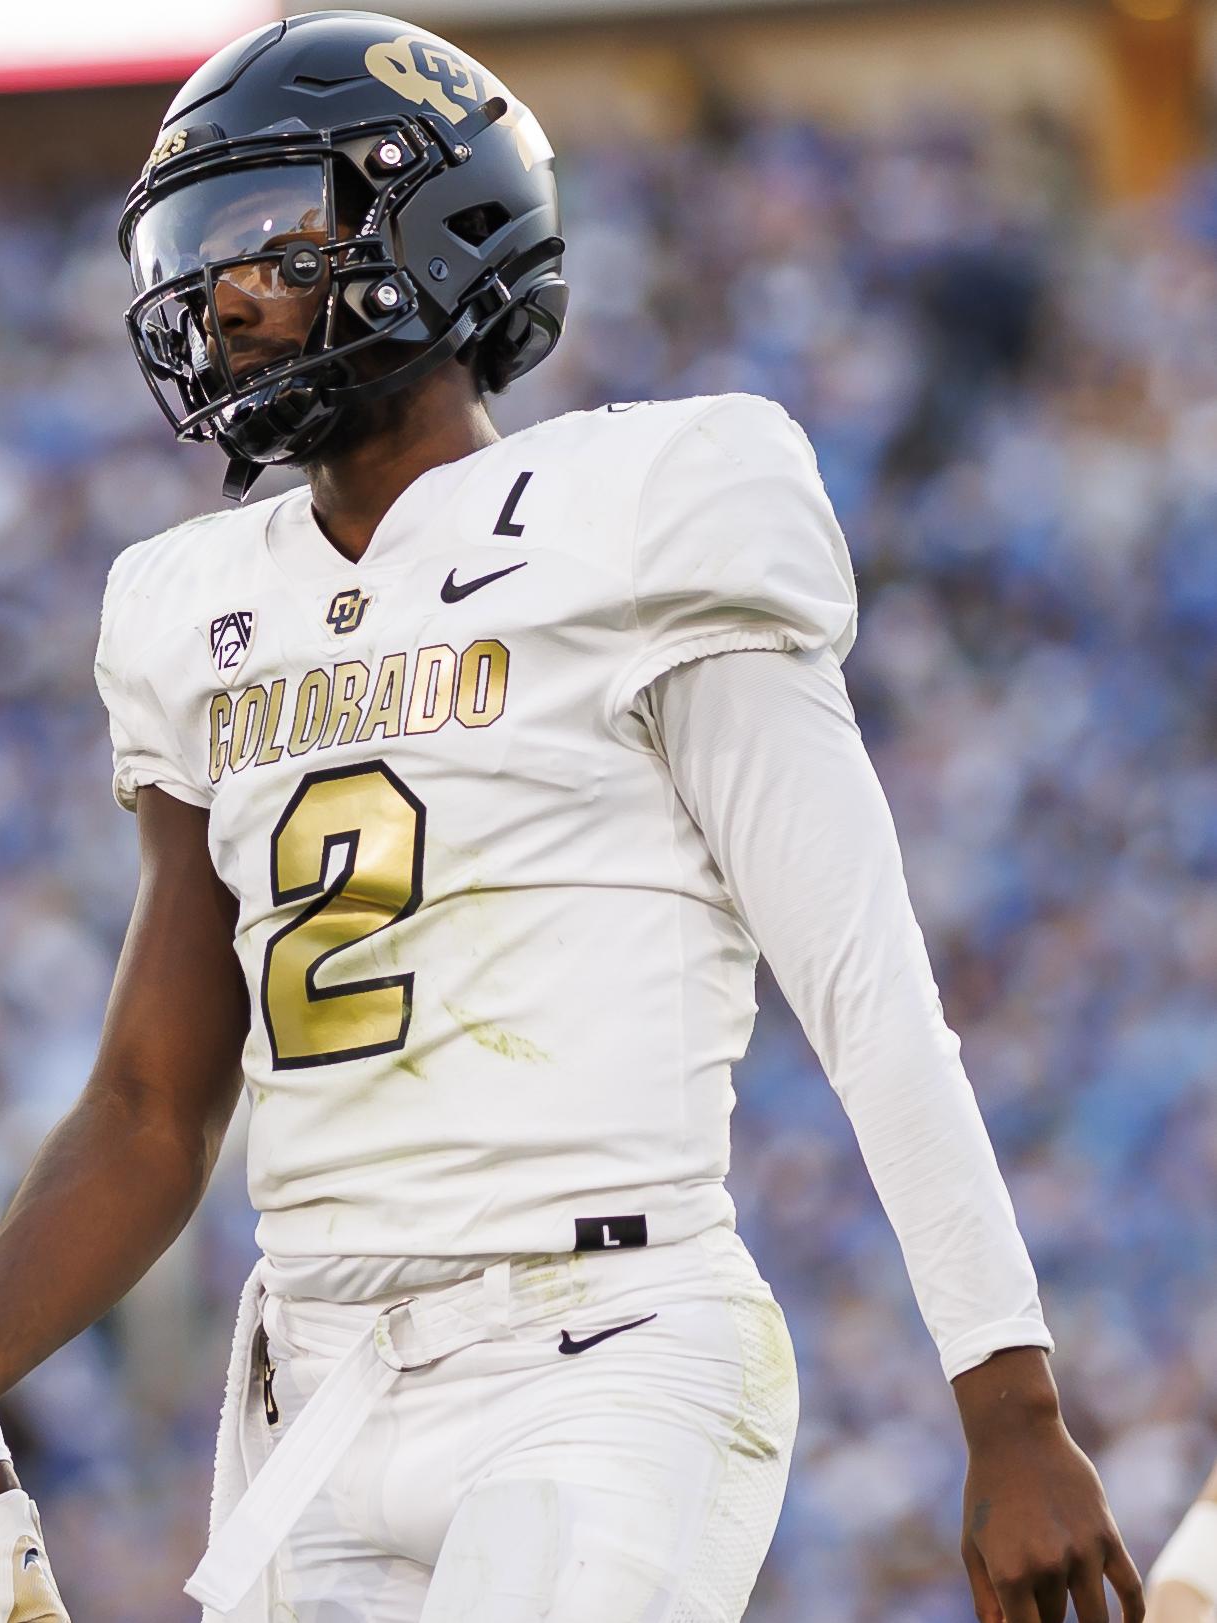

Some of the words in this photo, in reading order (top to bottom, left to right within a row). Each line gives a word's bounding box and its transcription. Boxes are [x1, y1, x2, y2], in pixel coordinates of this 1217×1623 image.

[492, 471, 534, 537] L
[210, 611, 253, 659] PAC
[326, 588, 370, 635] CU
[217, 641, 241, 671] 12
[208, 639, 511, 784] COLORADO
[261, 758, 427, 1072] 2
[602, 1224, 622, 1247] L
